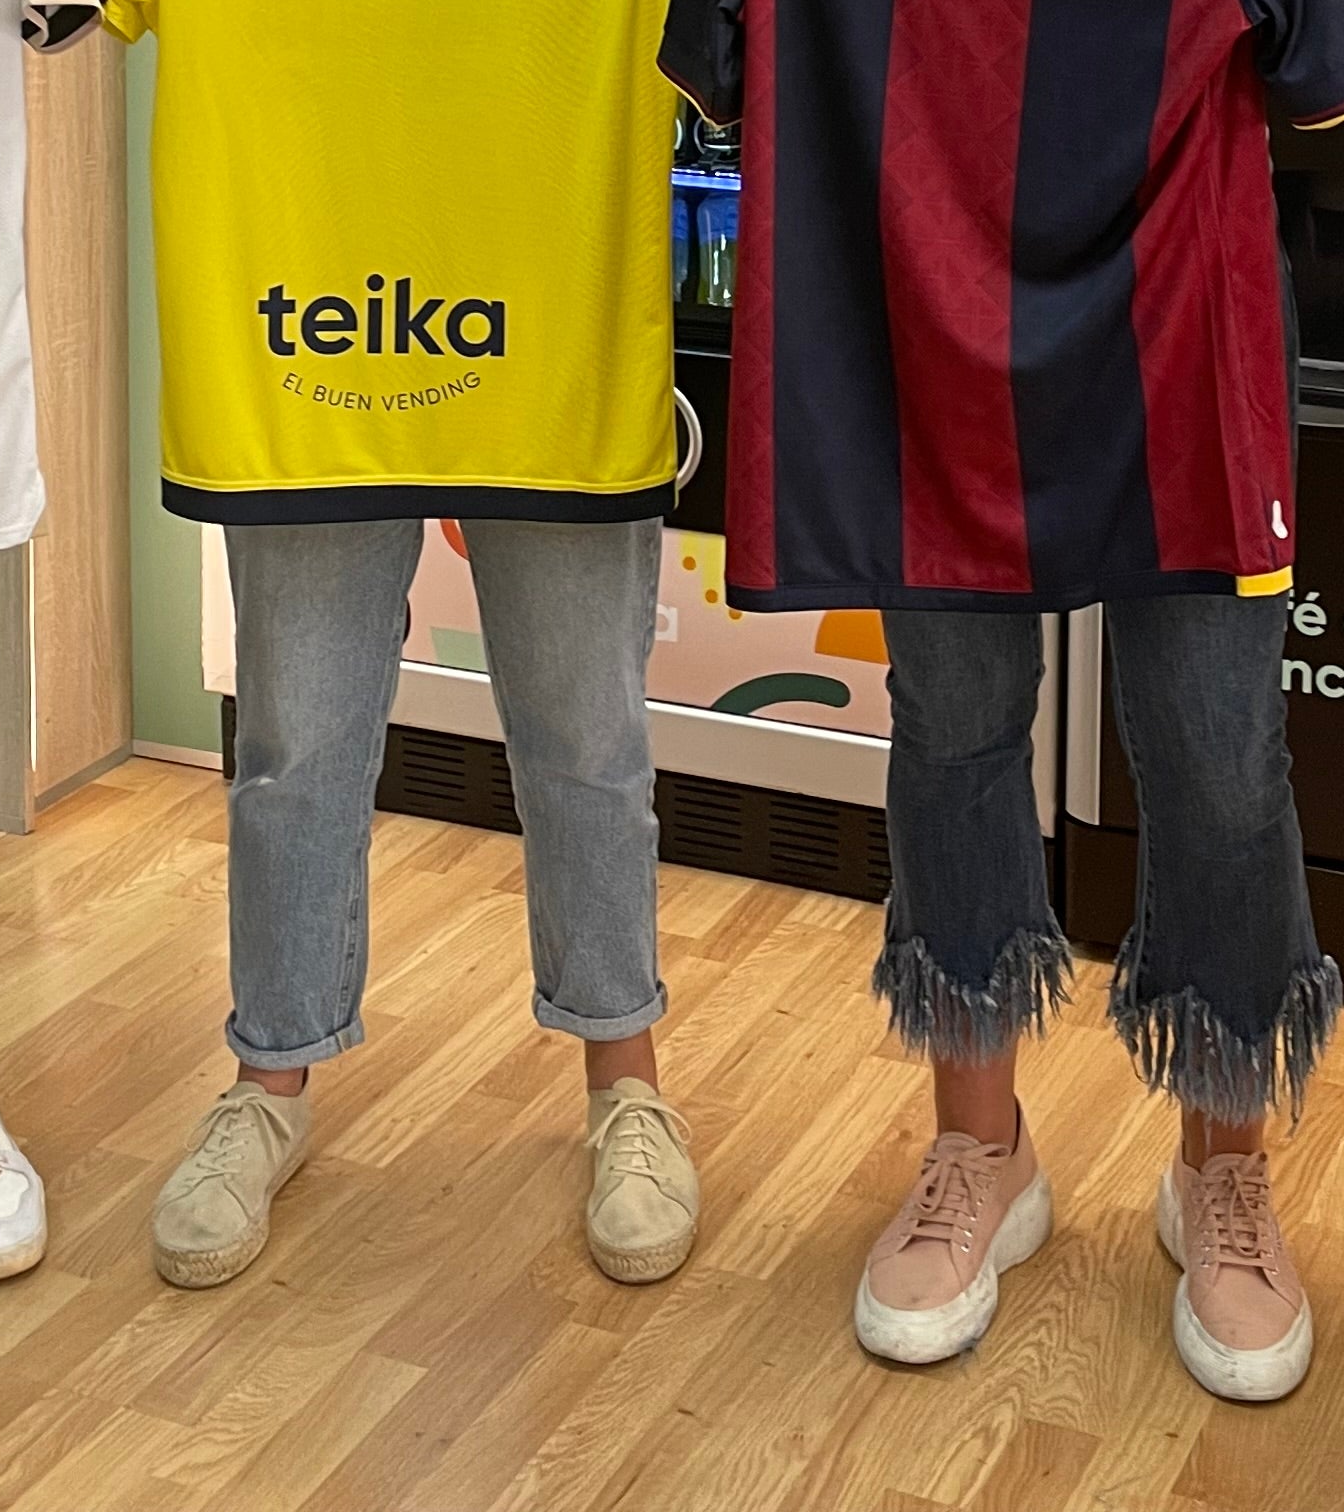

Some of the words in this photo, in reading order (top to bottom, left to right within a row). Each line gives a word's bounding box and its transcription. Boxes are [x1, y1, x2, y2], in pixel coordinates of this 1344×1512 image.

[257, 273, 506, 358] teika
[281, 371, 305, 396] EL
[311, 384, 373, 412] BUEN
[380, 370, 482, 412] VENDING
